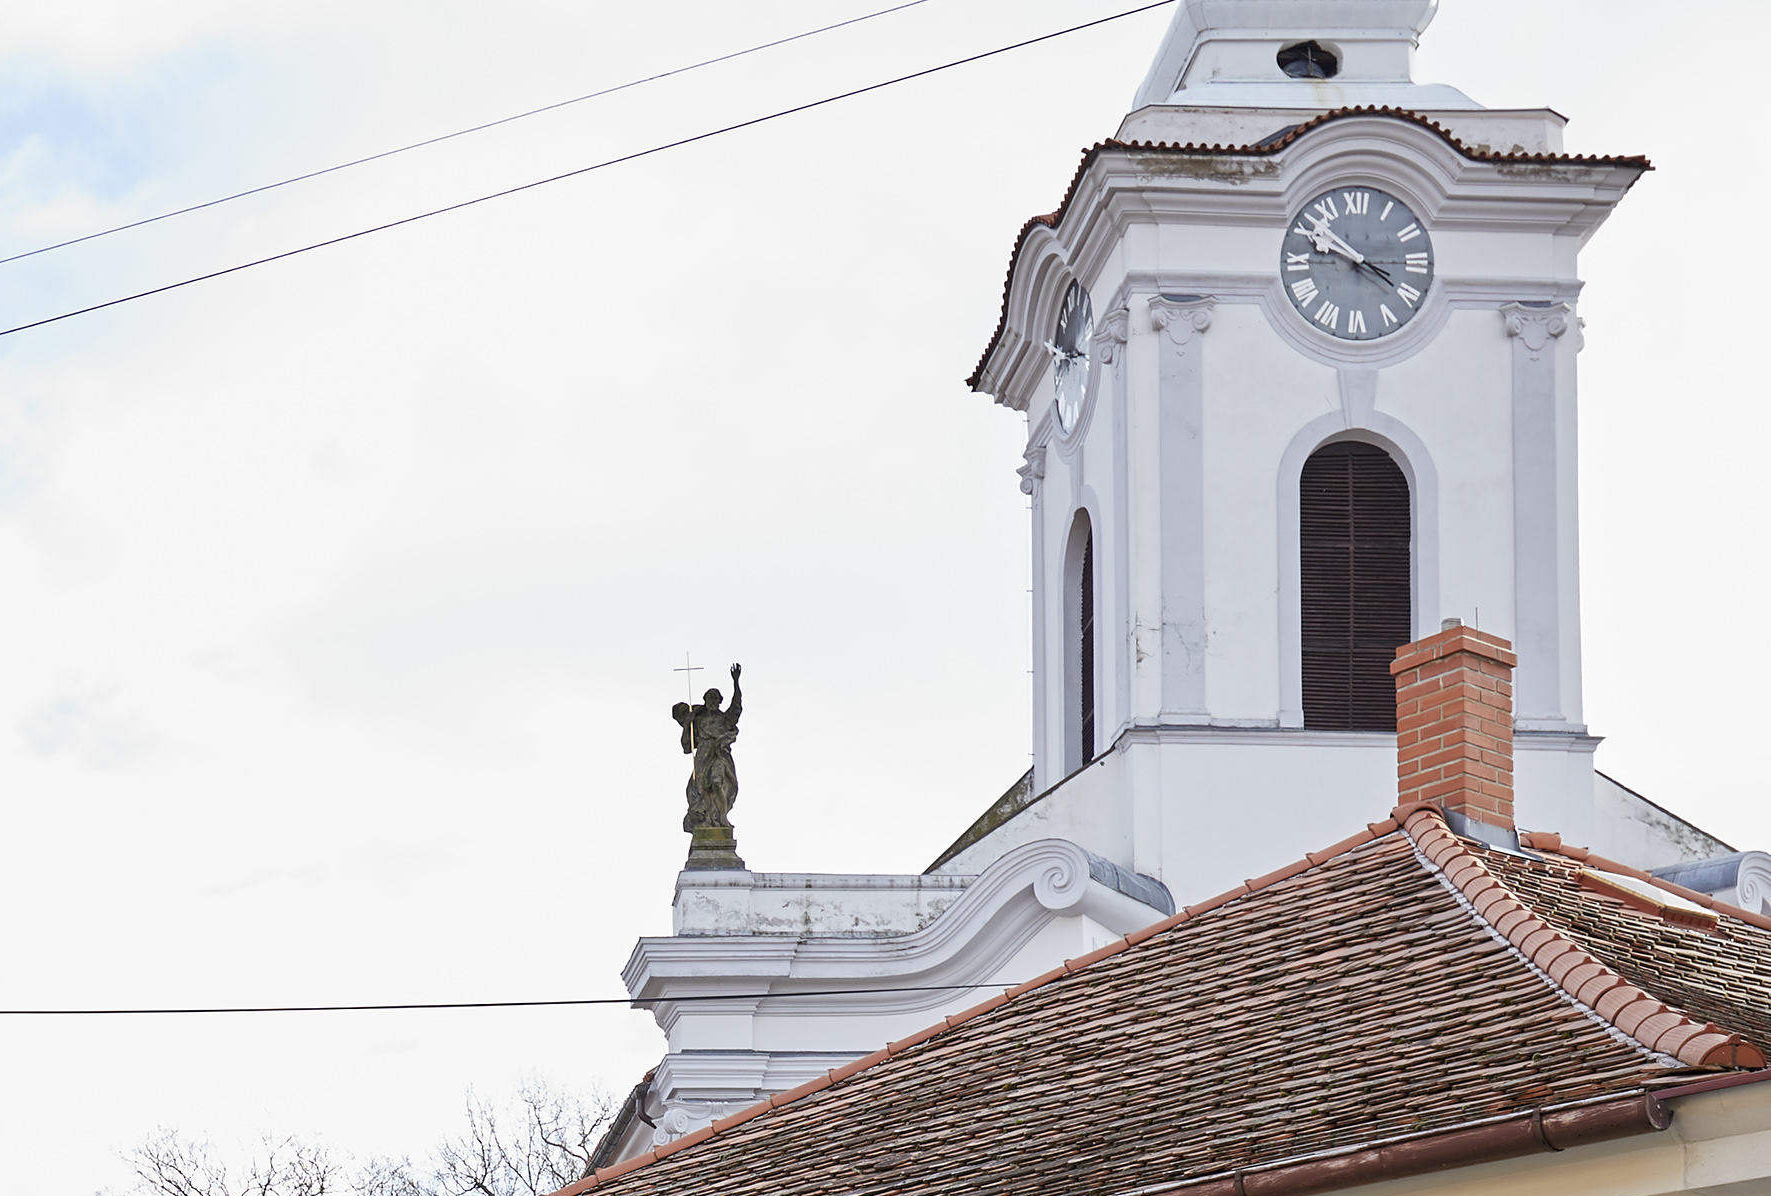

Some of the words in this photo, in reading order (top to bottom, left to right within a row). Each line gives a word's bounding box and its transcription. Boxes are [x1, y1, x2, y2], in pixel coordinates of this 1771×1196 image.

[1314, 197, 1338, 220] XI
[1344, 192, 1369, 214] XII
[1380, 201, 1394, 221] I
[1397, 223, 1421, 242] II
[1287, 252, 1309, 271] IX
[1405, 252, 1428, 274] III
[1291, 278, 1318, 308] VIII
[1397, 282, 1421, 308] IV
[1314, 300, 1339, 330] VII
[1348, 310, 1366, 333] VI
[1380, 304, 1398, 327] V
